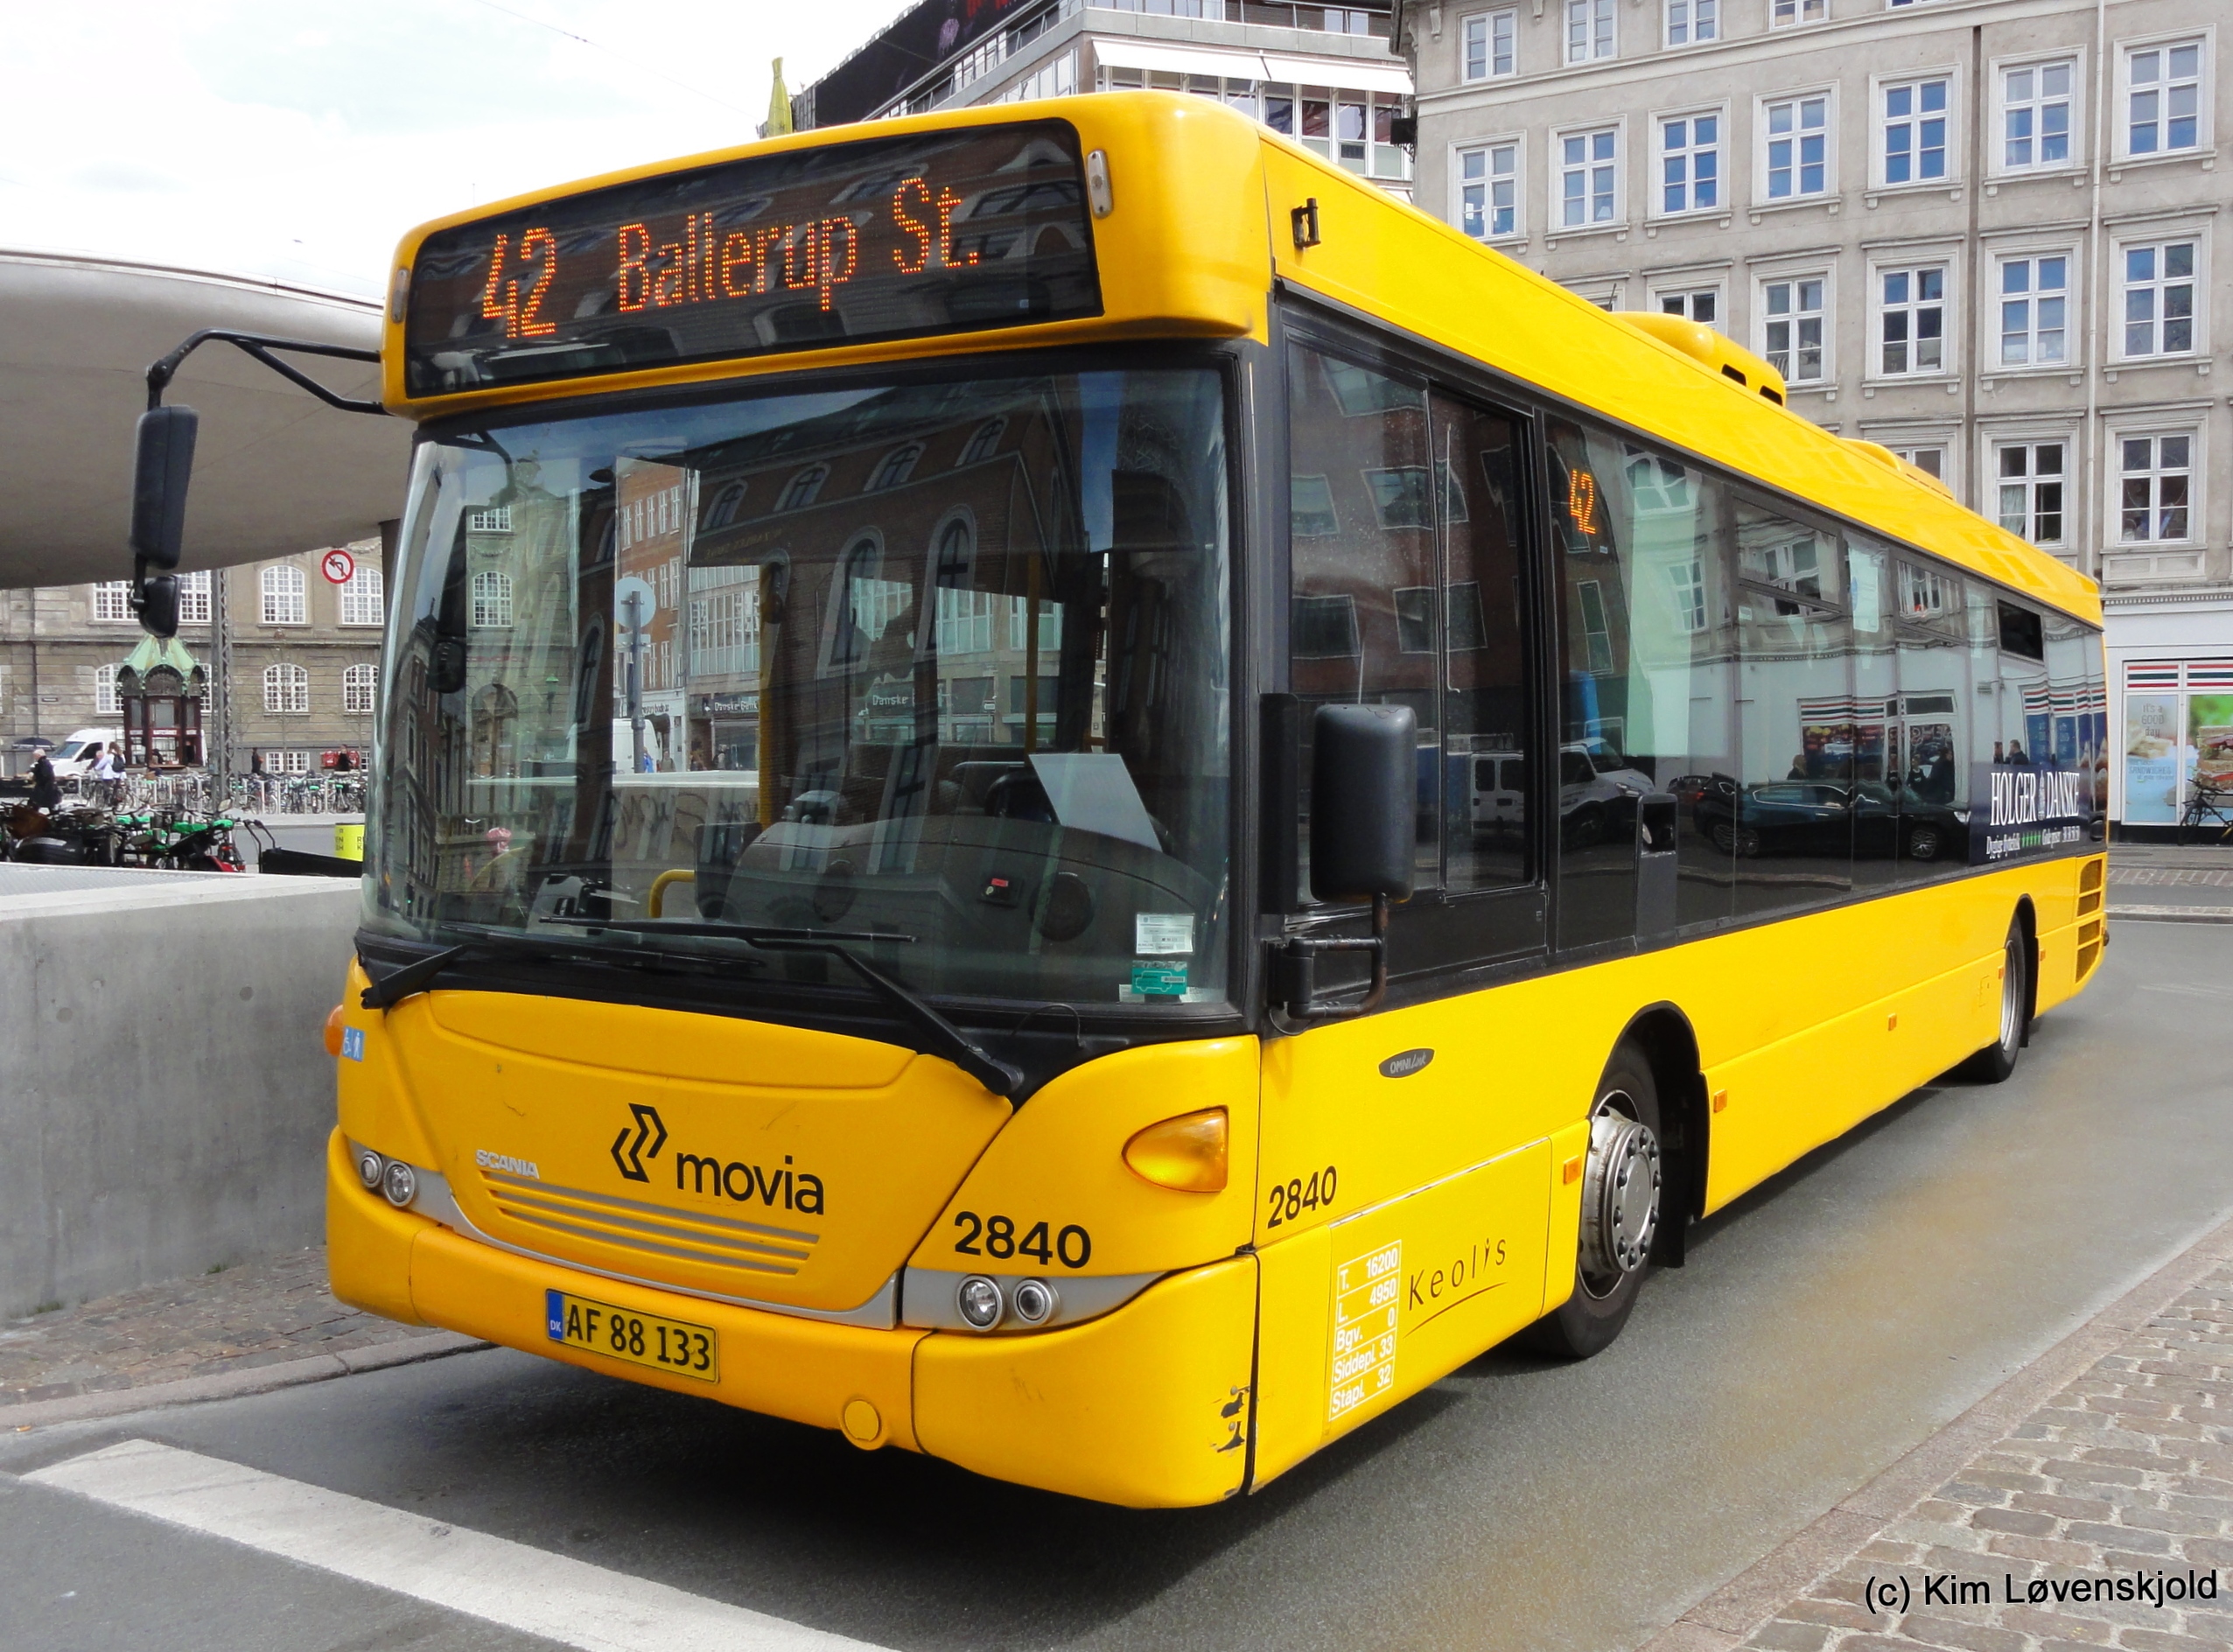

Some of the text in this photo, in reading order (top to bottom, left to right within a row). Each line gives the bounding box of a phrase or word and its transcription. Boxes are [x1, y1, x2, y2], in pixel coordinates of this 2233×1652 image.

[482, 177, 980, 340] 42 Ballerup St.
[1569, 468, 1597, 535] 42
[2141, 715, 2165, 725] GOOD
[1990, 771, 2080, 826] HOLGER DANSKE
[475, 1149, 540, 1180] SCANIA
[676, 1155, 825, 1216] movia
[1266, 1166, 1338, 1229] 2840
[954, 1210, 1092, 1270] 2840
[1340, 1247, 1398, 1291] T. 16200
[1408, 1237, 1507, 1312] Keolis
[1337, 1277, 1396, 1323] L. 4950
[550, 1304, 710, 1371] DK AF 88 133
[1335, 1306, 1396, 1353] Bgv. 0
[1334, 1334, 1394, 1383] Siddepl. 33
[1376, 1364, 1391, 1389] 32
